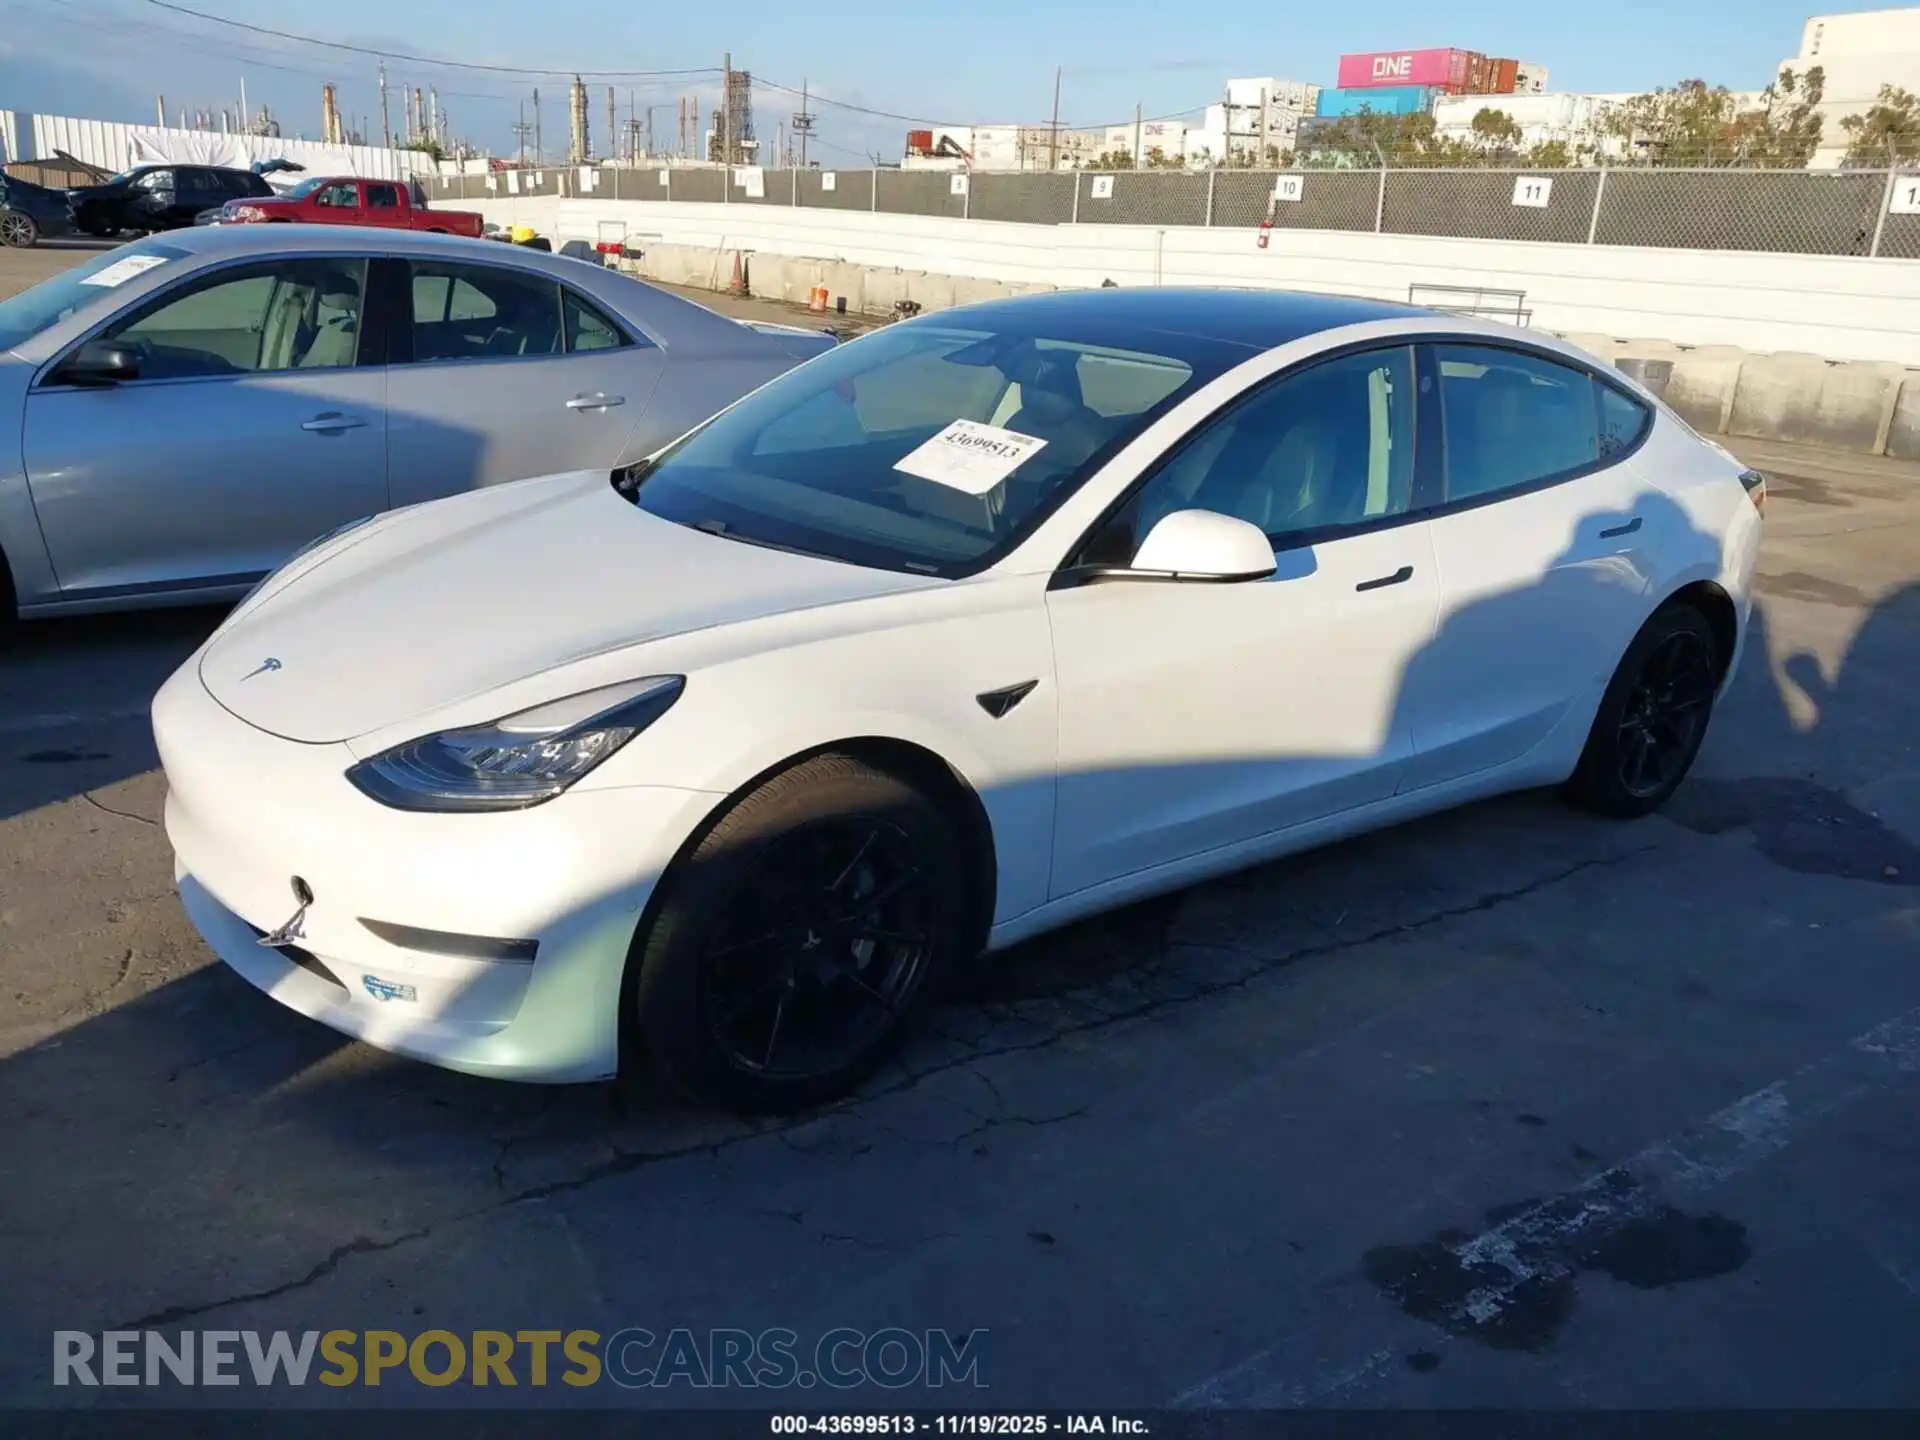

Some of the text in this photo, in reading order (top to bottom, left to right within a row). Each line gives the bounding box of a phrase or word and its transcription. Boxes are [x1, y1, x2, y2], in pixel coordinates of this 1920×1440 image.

[1372, 55, 1413, 77] ONE
[1283, 181, 1296, 194] 10
[1525, 184, 1541, 200] 11
[1908, 187, 1920, 205] 1
